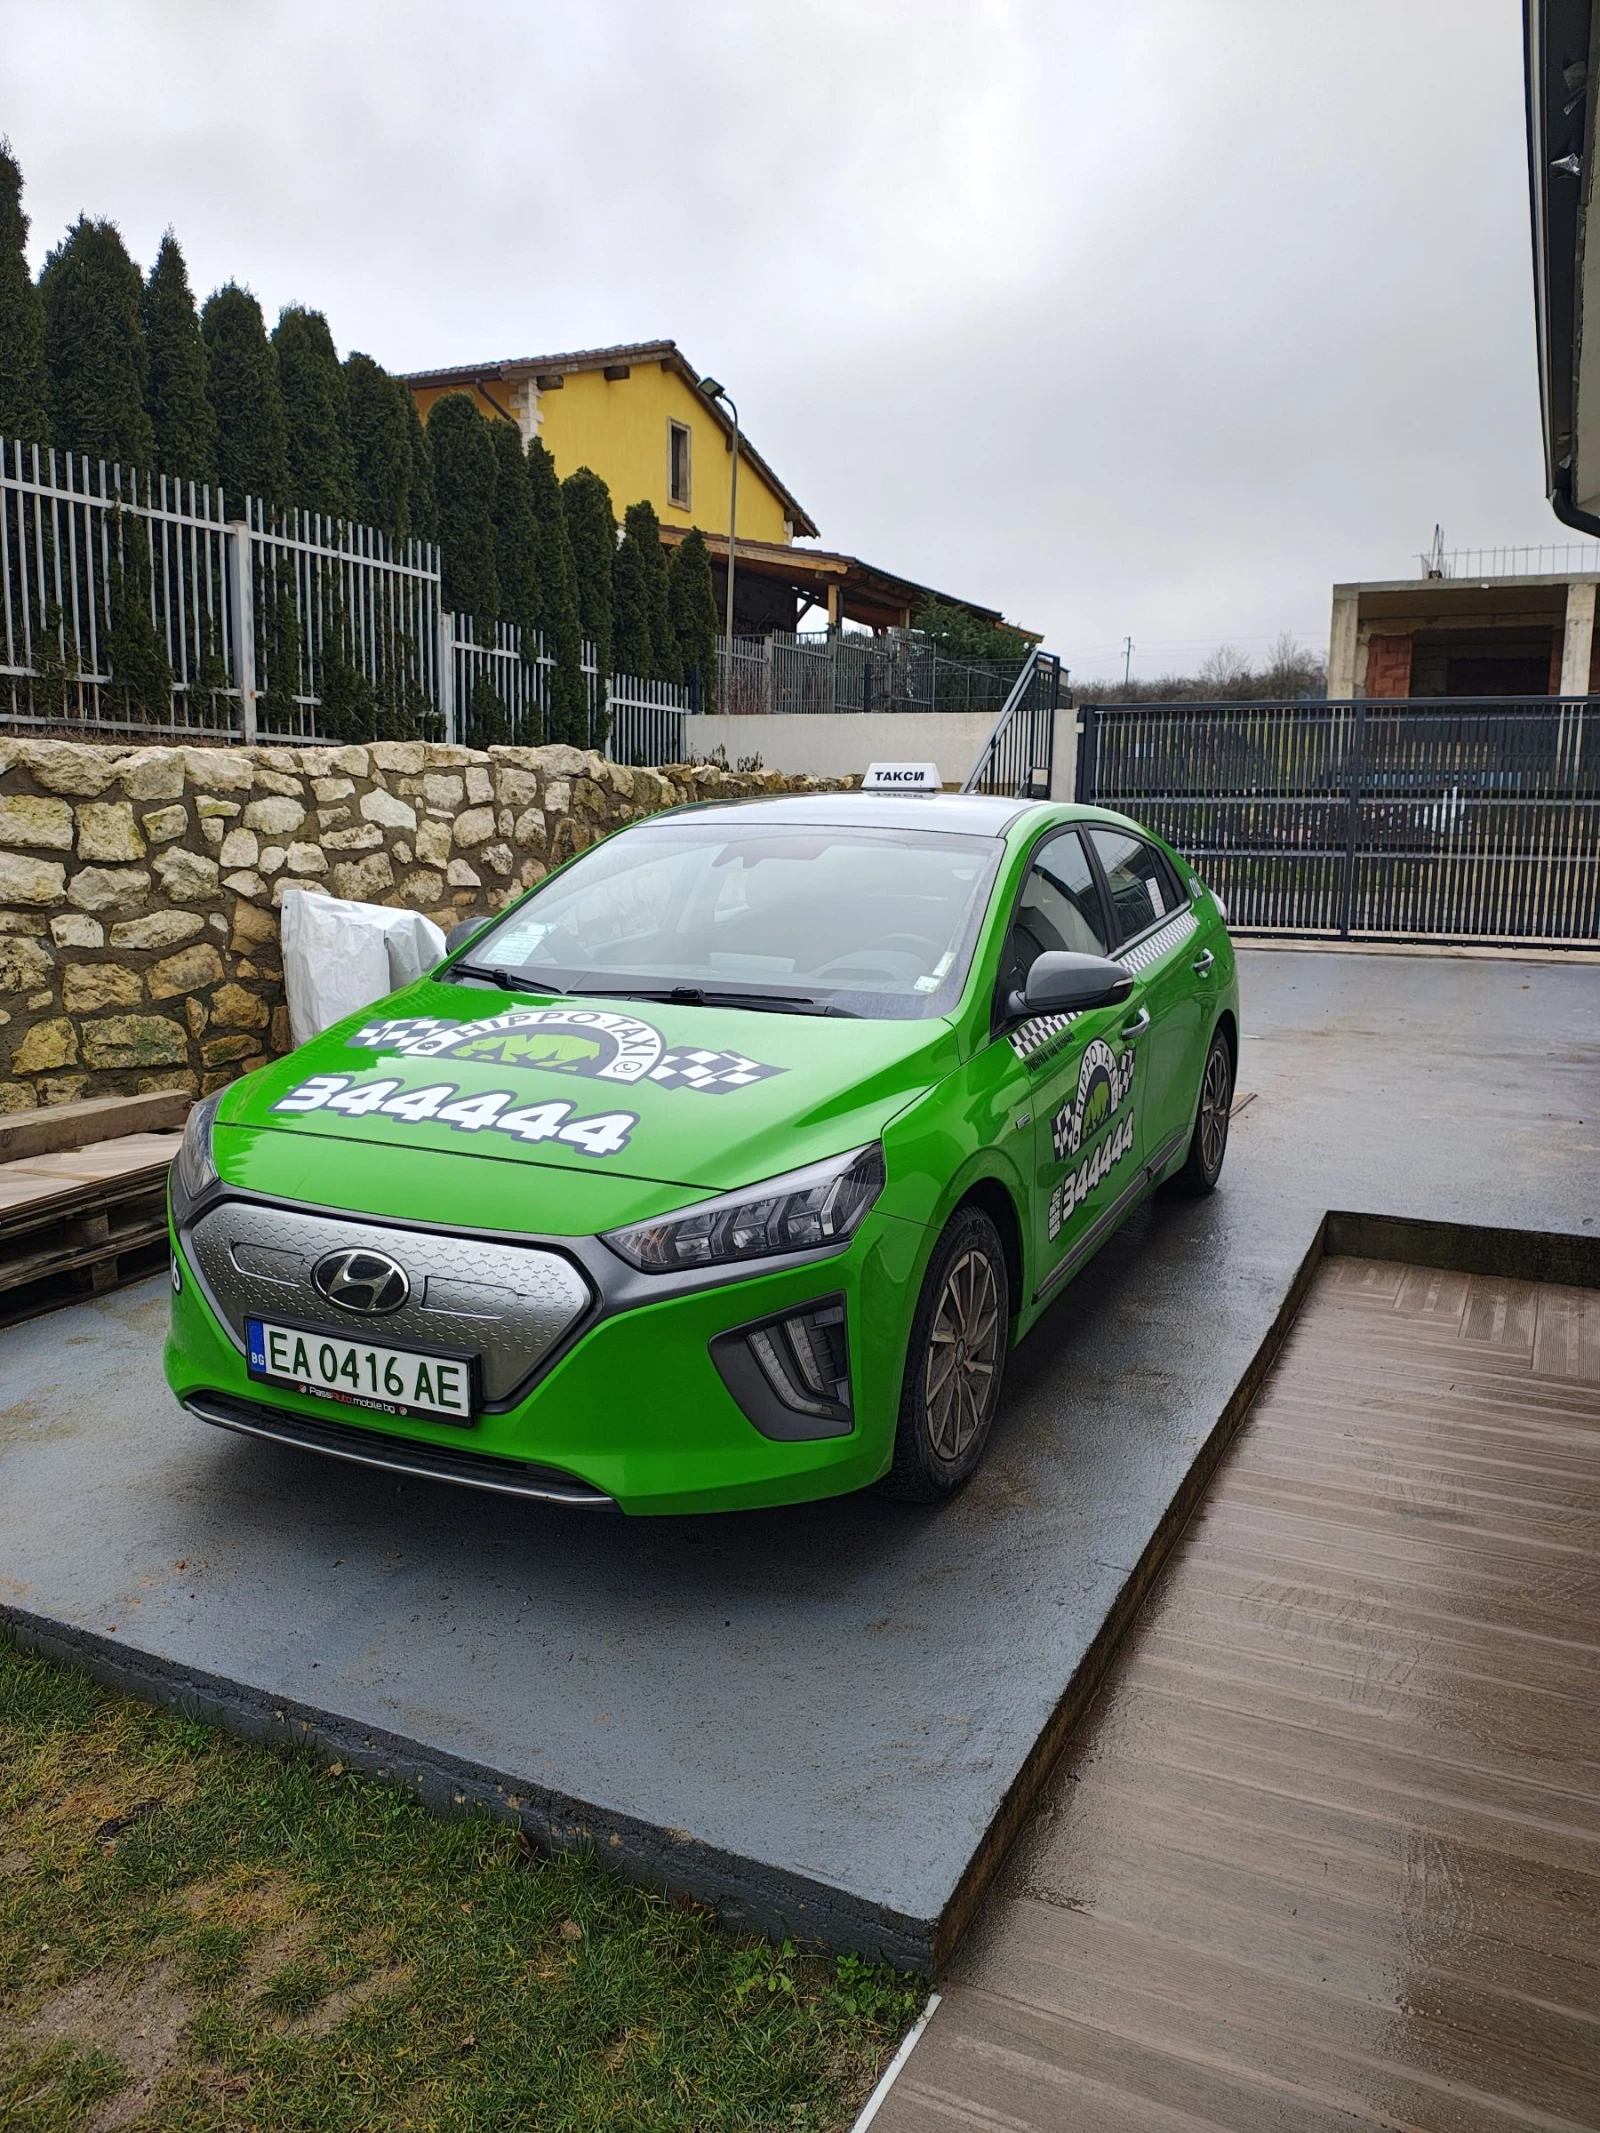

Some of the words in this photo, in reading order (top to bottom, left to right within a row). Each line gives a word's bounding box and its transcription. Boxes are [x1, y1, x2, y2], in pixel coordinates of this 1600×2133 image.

[874, 771, 925, 781] ТАКСИ
[611, 1018, 657, 1057] TAXI
[273, 1076, 636, 1154] 344444
[1062, 1110, 1134, 1222] 344444
[251, 1352, 265, 1366] BG
[319, 1343, 404, 1396] 0416
